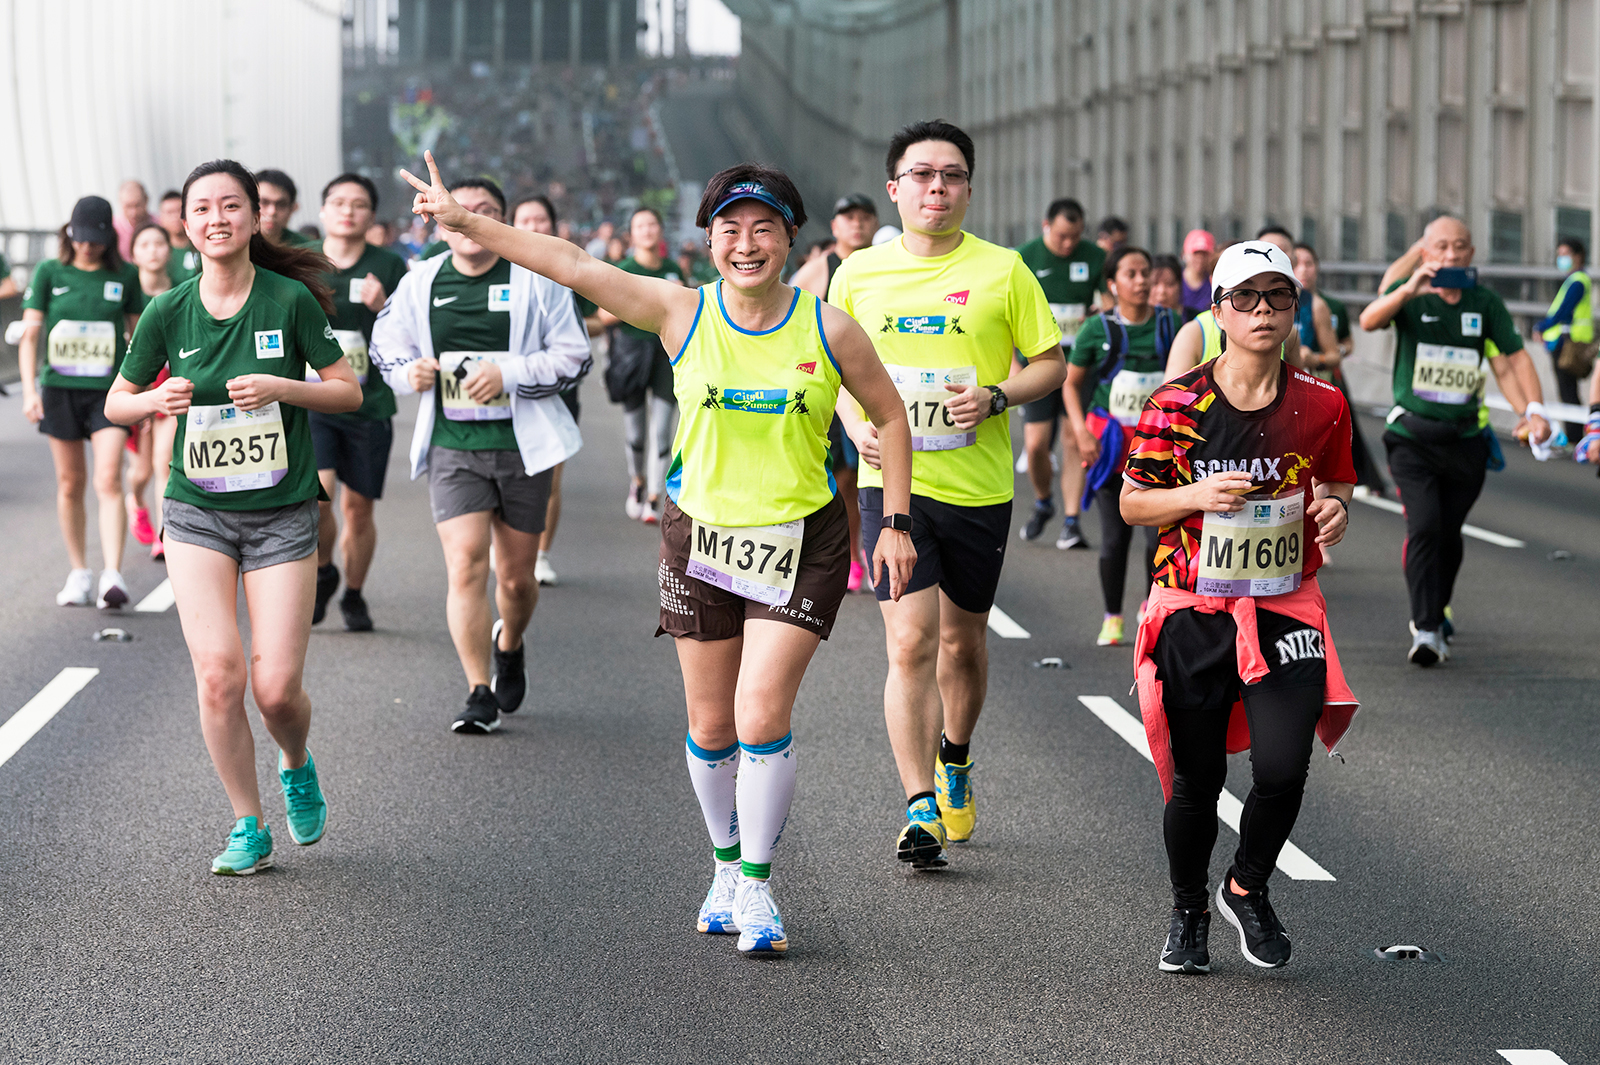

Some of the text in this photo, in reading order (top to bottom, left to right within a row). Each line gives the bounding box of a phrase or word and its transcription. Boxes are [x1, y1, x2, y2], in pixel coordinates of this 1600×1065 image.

[55, 342, 111, 359] M3544
[1294, 372, 1315, 385] HONG
[1418, 367, 1476, 389] M2500
[732, 391, 764, 403] CityU
[739, 400, 779, 411] Runner
[1114, 394, 1146, 411] M26
[190, 432, 279, 469] M2357
[697, 525, 794, 579] M1374
[1206, 532, 1300, 569] M1609
[768, 605, 825, 627] FINEPRINT
